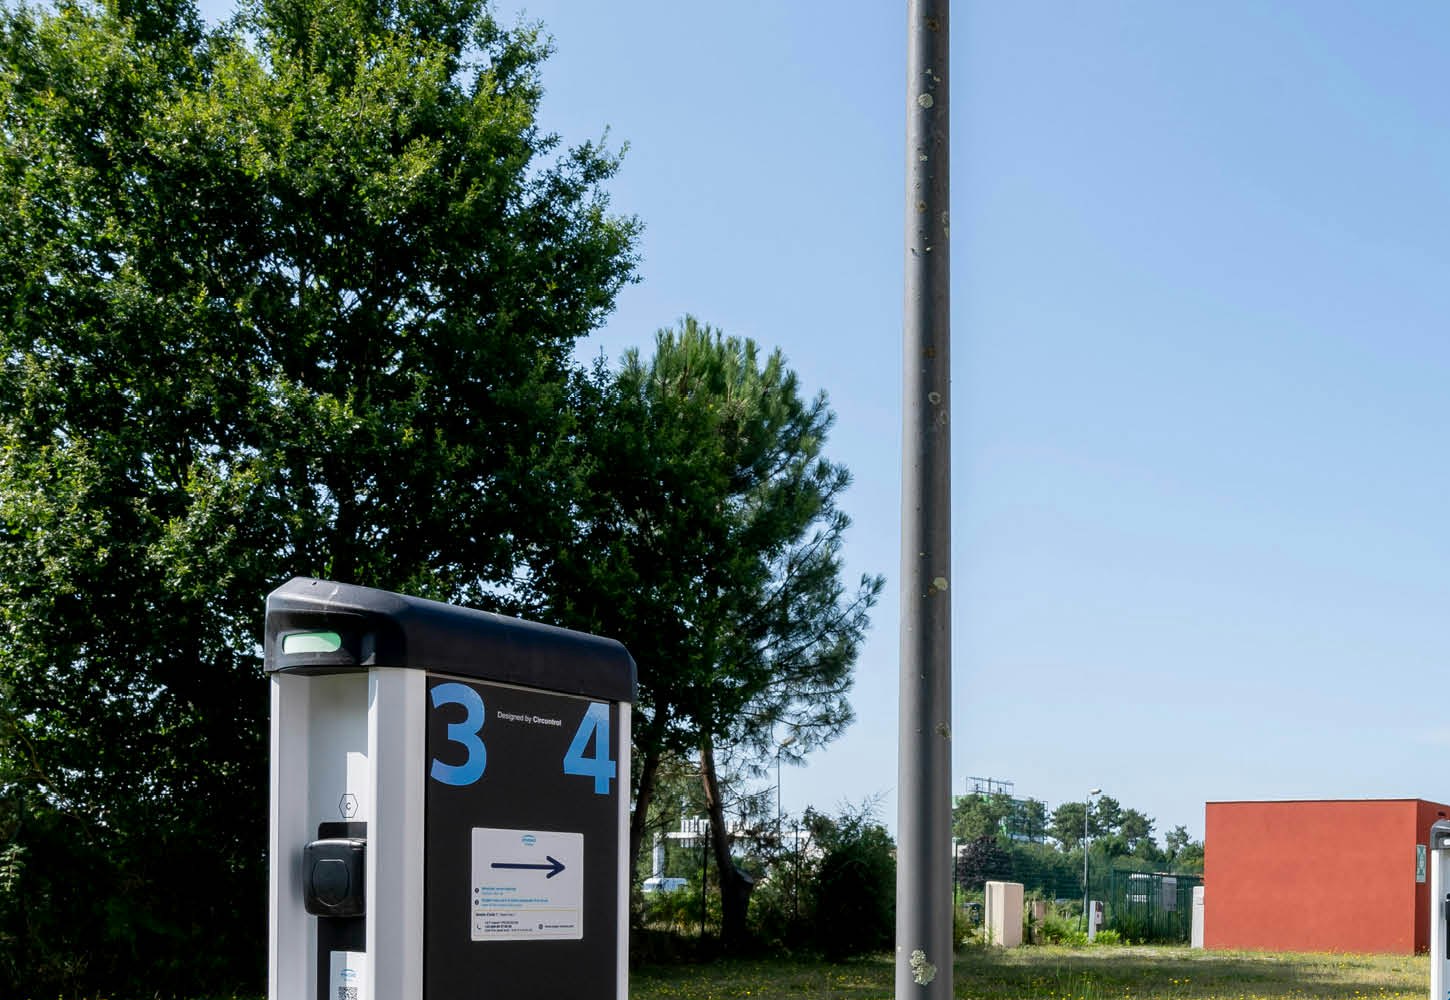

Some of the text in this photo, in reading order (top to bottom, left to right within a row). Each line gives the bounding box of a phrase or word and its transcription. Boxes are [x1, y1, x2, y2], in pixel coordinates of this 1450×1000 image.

[430, 682, 487, 786] 3
[497, 711, 562, 727] Designed by Circontrol
[563, 701, 617, 795] 4
